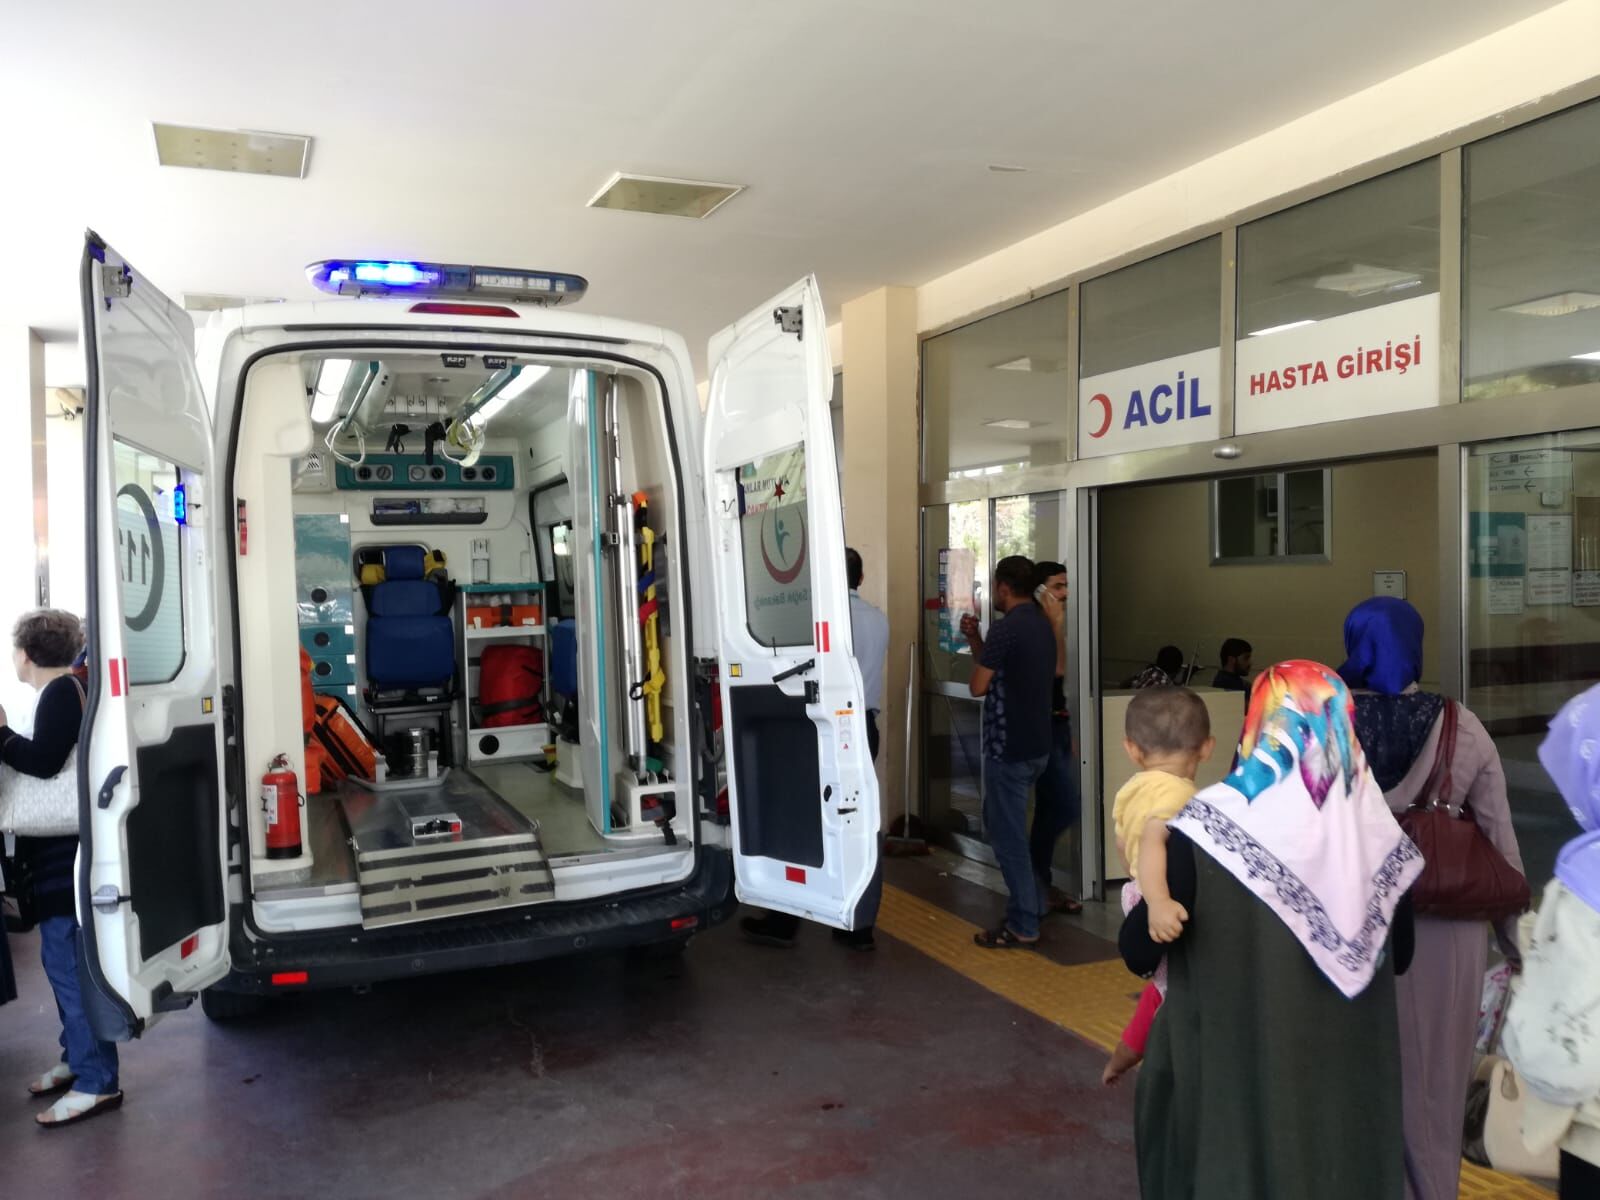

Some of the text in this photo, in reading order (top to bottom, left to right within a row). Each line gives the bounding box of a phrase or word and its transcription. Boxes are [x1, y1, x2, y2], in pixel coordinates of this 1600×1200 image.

[1250, 334, 1421, 396] HASTA GİRİŞİ
[1123, 371, 1211, 430] ACİL
